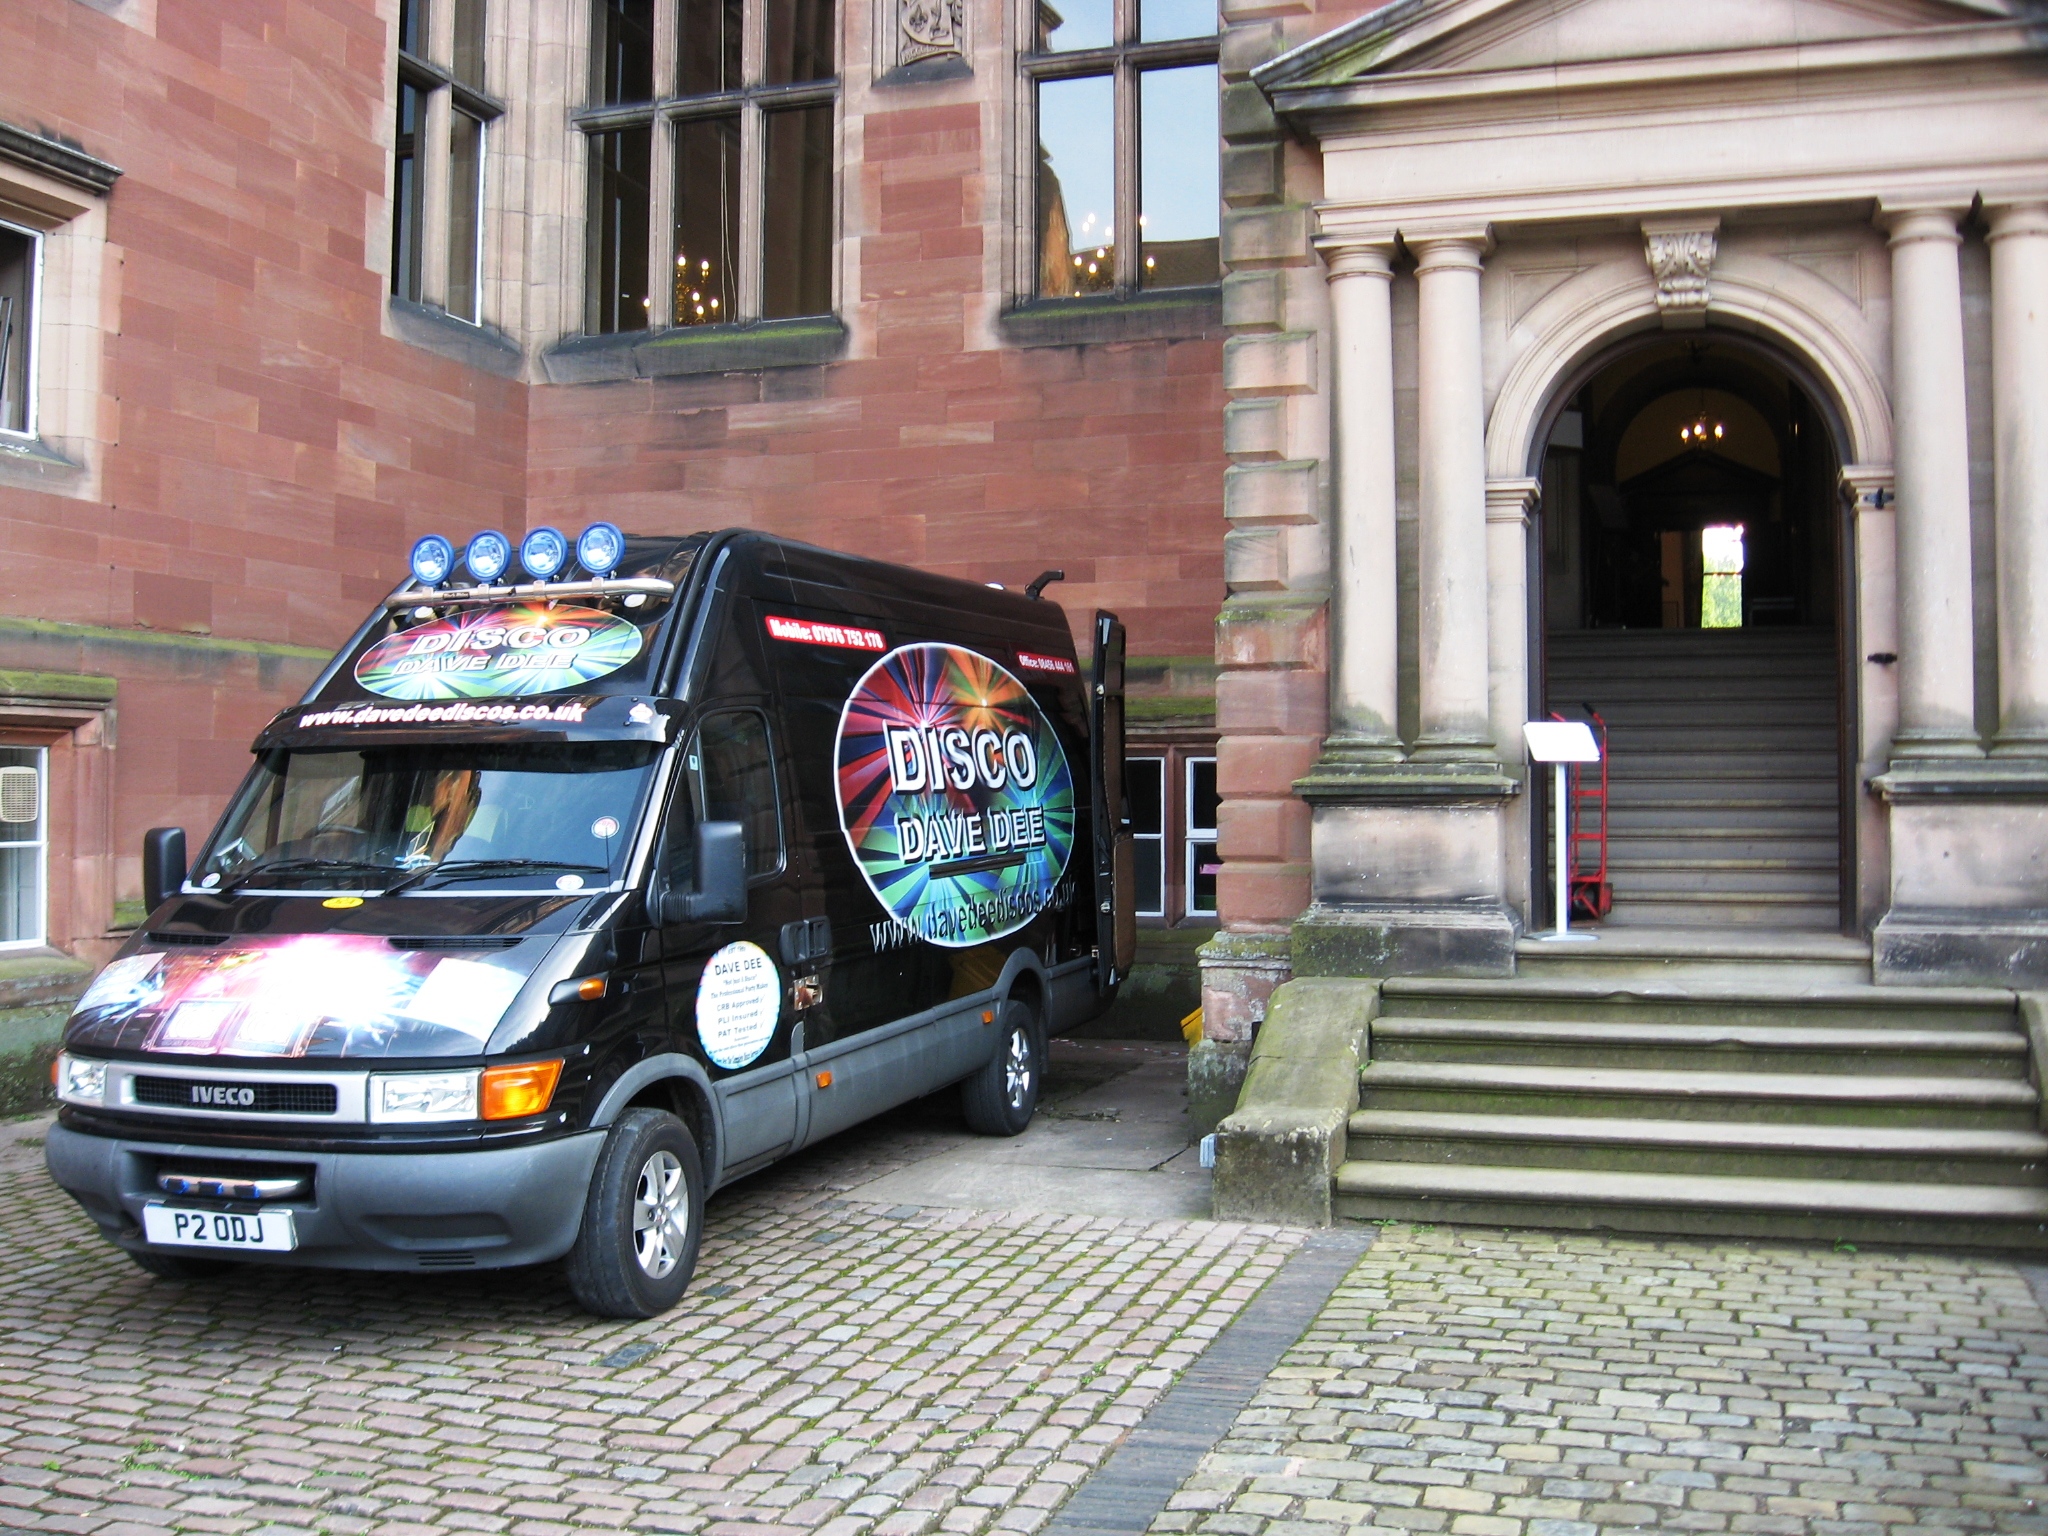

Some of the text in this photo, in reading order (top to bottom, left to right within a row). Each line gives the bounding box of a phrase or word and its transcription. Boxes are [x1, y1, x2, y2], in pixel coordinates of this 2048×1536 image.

[407, 625, 590, 656] DISCO
[769, 619, 812, 640] Mobile:
[391, 652, 578, 676] DAVE DEE
[299, 701, 588, 728] www.davedeediscos.co.uk
[882, 719, 1038, 793] DISCO
[894, 804, 1047, 864] DAVE DEE
[868, 879, 1077, 954] www.davedeediscos.co.uk
[714, 957, 763, 976] DAVE DEE
[716, 997, 760, 1012] CRB Approved
[732, 1009, 758, 1022] Insured
[717, 1022, 758, 1038] PAT Tested
[192, 1084, 255, 1106] IVECO
[174, 1213, 207, 1240] P2
